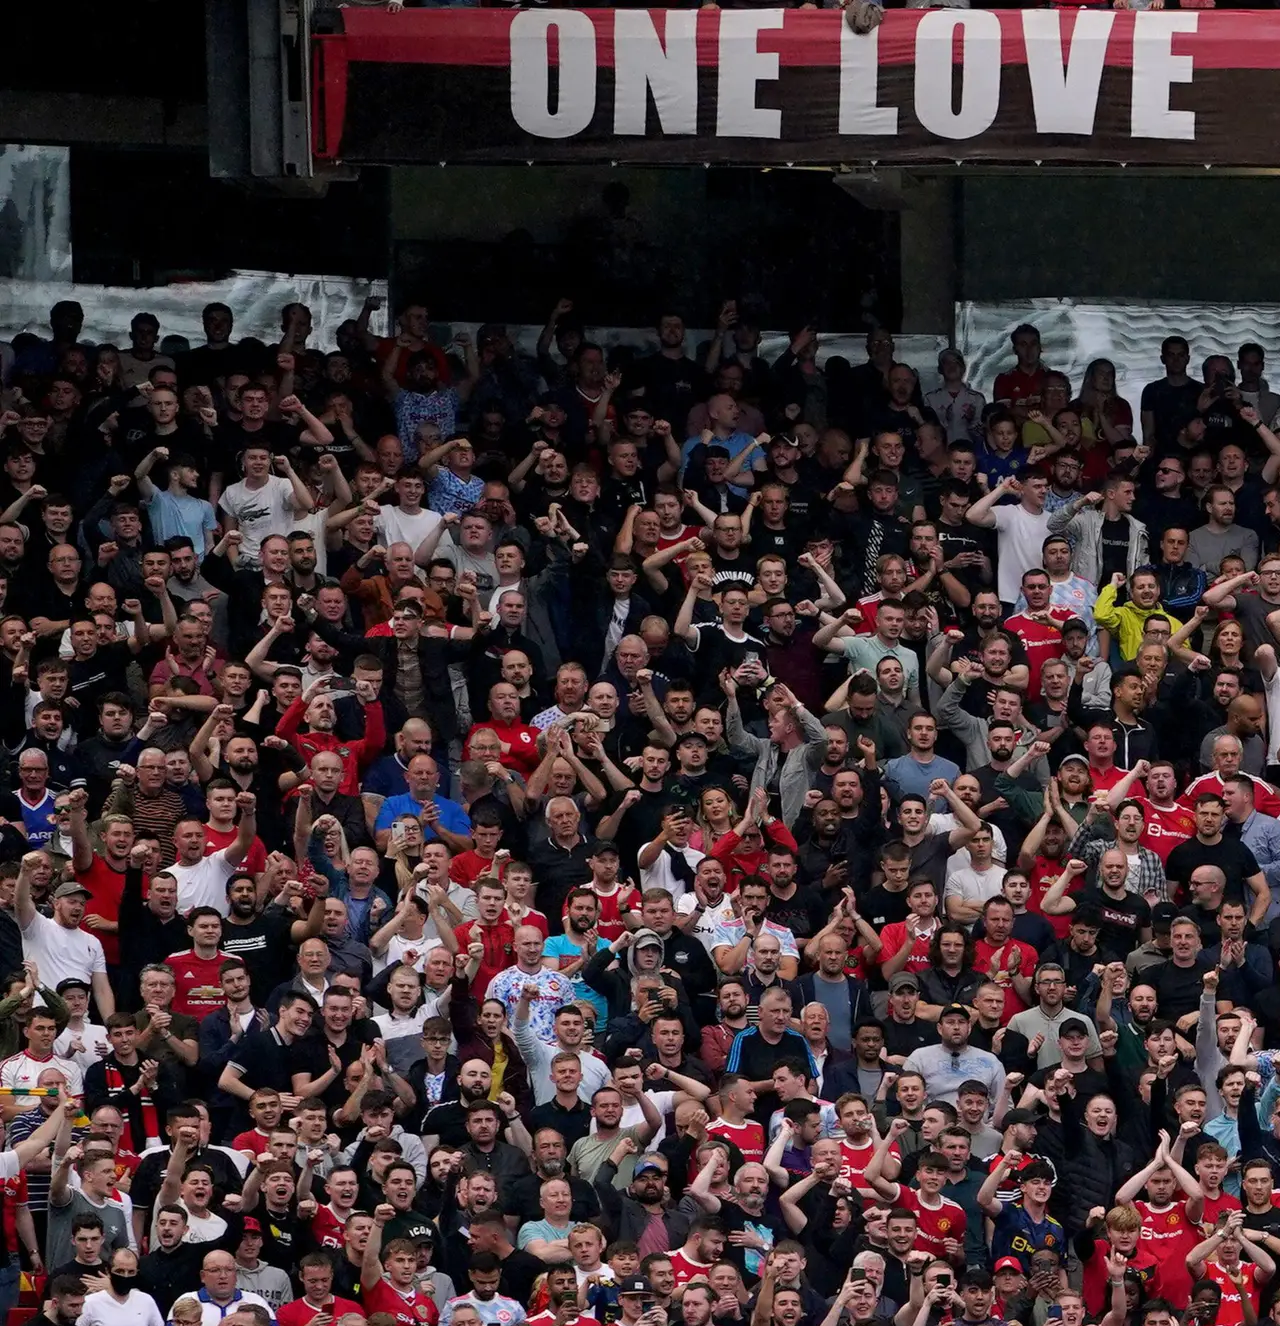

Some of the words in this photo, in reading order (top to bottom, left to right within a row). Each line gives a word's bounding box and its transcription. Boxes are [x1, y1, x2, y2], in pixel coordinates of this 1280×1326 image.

[510, 8, 785, 139] ONE
[838, 8, 1199, 141] LOVE
[520, 732, 531, 743] 6
[692, 925, 714, 934] SHA
[408, 1225, 432, 1237] ICON
